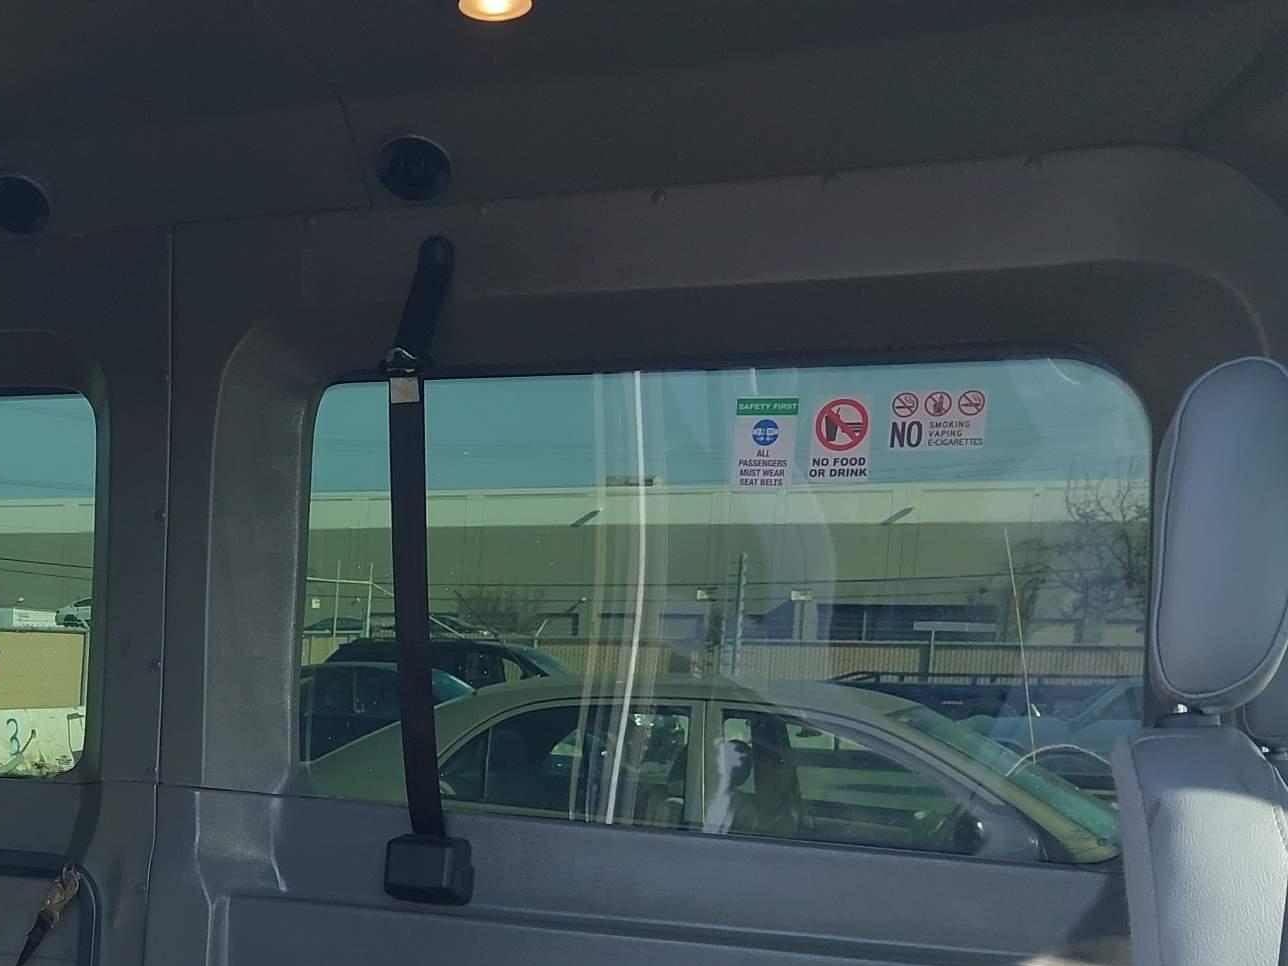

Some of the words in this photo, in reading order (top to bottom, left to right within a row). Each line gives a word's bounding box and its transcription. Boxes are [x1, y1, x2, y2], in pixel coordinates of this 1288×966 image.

[738, 402, 770, 410] SAFETY
[773, 402, 798, 410] FIRST
[929, 420, 971, 429] SMOKING
[889, 420, 923, 448] NO
[928, 429, 962, 438] VAPING
[927, 437, 984, 447] E-CIGARETTES
[756, 449, 770, 458] ALL
[738, 459, 788, 468] PASSENGERS
[812, 457, 830, 467] NO
[833, 457, 866, 467] FOOD
[739, 468, 761, 477] MUST
[763, 468, 785, 477] WEAR
[809, 468, 825, 478] OR
[829, 468, 868, 478] DRINK
[739, 478, 759, 487] SEAT
[760, 478, 784, 487] BELTS
[6, 718, 21, 756] 3
